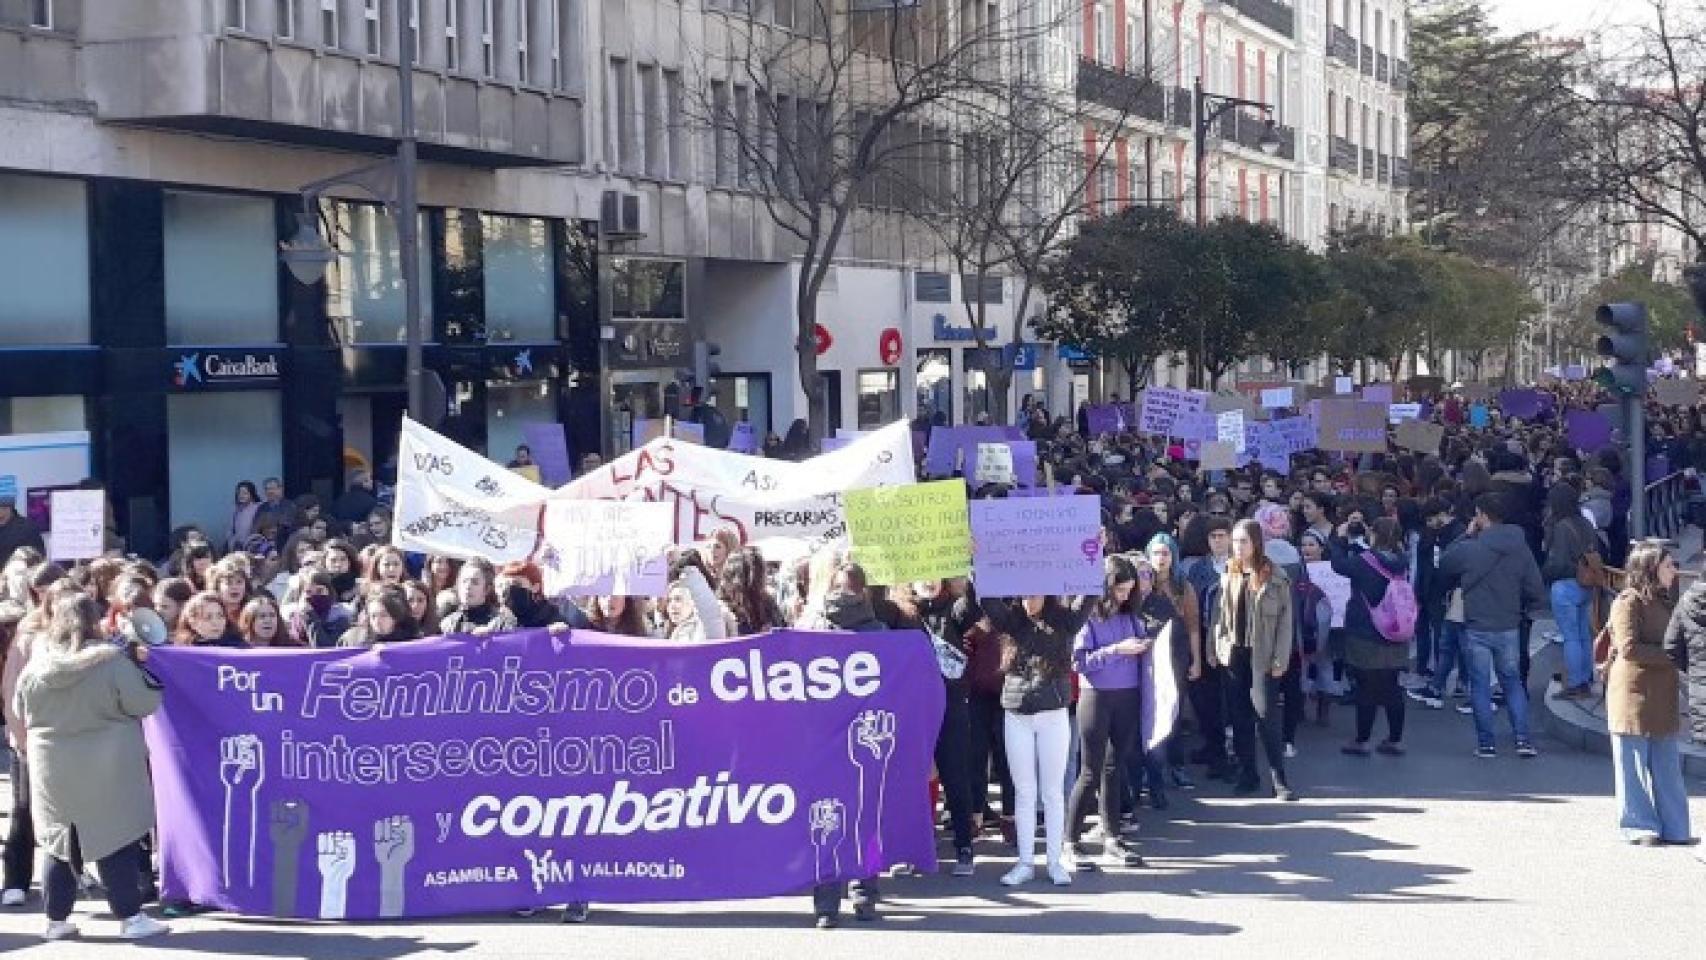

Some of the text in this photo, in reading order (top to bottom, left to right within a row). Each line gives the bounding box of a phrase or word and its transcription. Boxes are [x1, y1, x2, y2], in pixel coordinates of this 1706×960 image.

[205, 353, 280, 376] CaixaBank
[610, 445, 675, 485] LAS
[754, 509, 845, 528] PRECARIAS
[217, 648, 881, 720] Por un Feminismo de clase
[281, 719, 675, 785] interseccional
[434, 770, 797, 843] y combativo
[423, 865, 520, 888] ASAMBLEA
